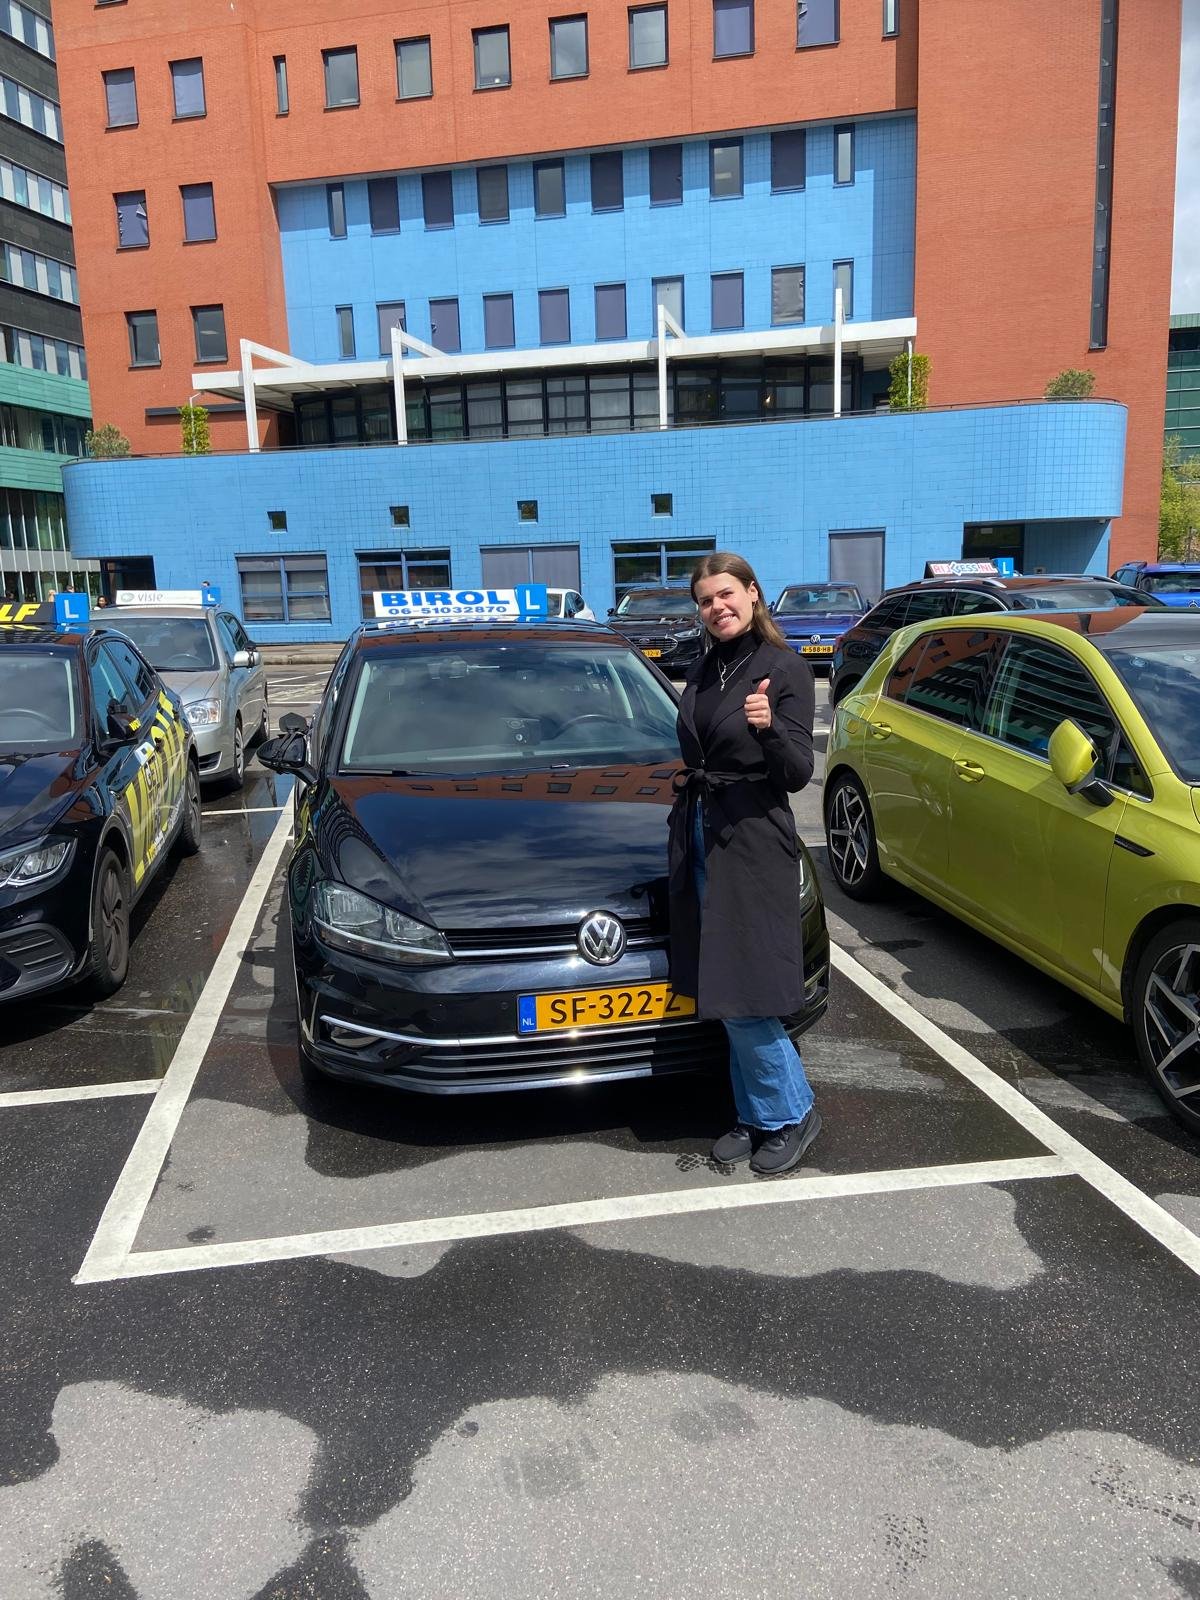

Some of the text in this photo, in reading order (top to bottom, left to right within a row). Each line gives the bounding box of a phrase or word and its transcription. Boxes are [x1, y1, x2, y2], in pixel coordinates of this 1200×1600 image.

[1002, 561, 1010, 575] L
[380, 590, 511, 607] BIROL
[525, 589, 541, 610] L
[64, 599, 80, 619] L
[388, 606, 507, 615] 06-51032870
[522, 1017, 535, 1027] NL
